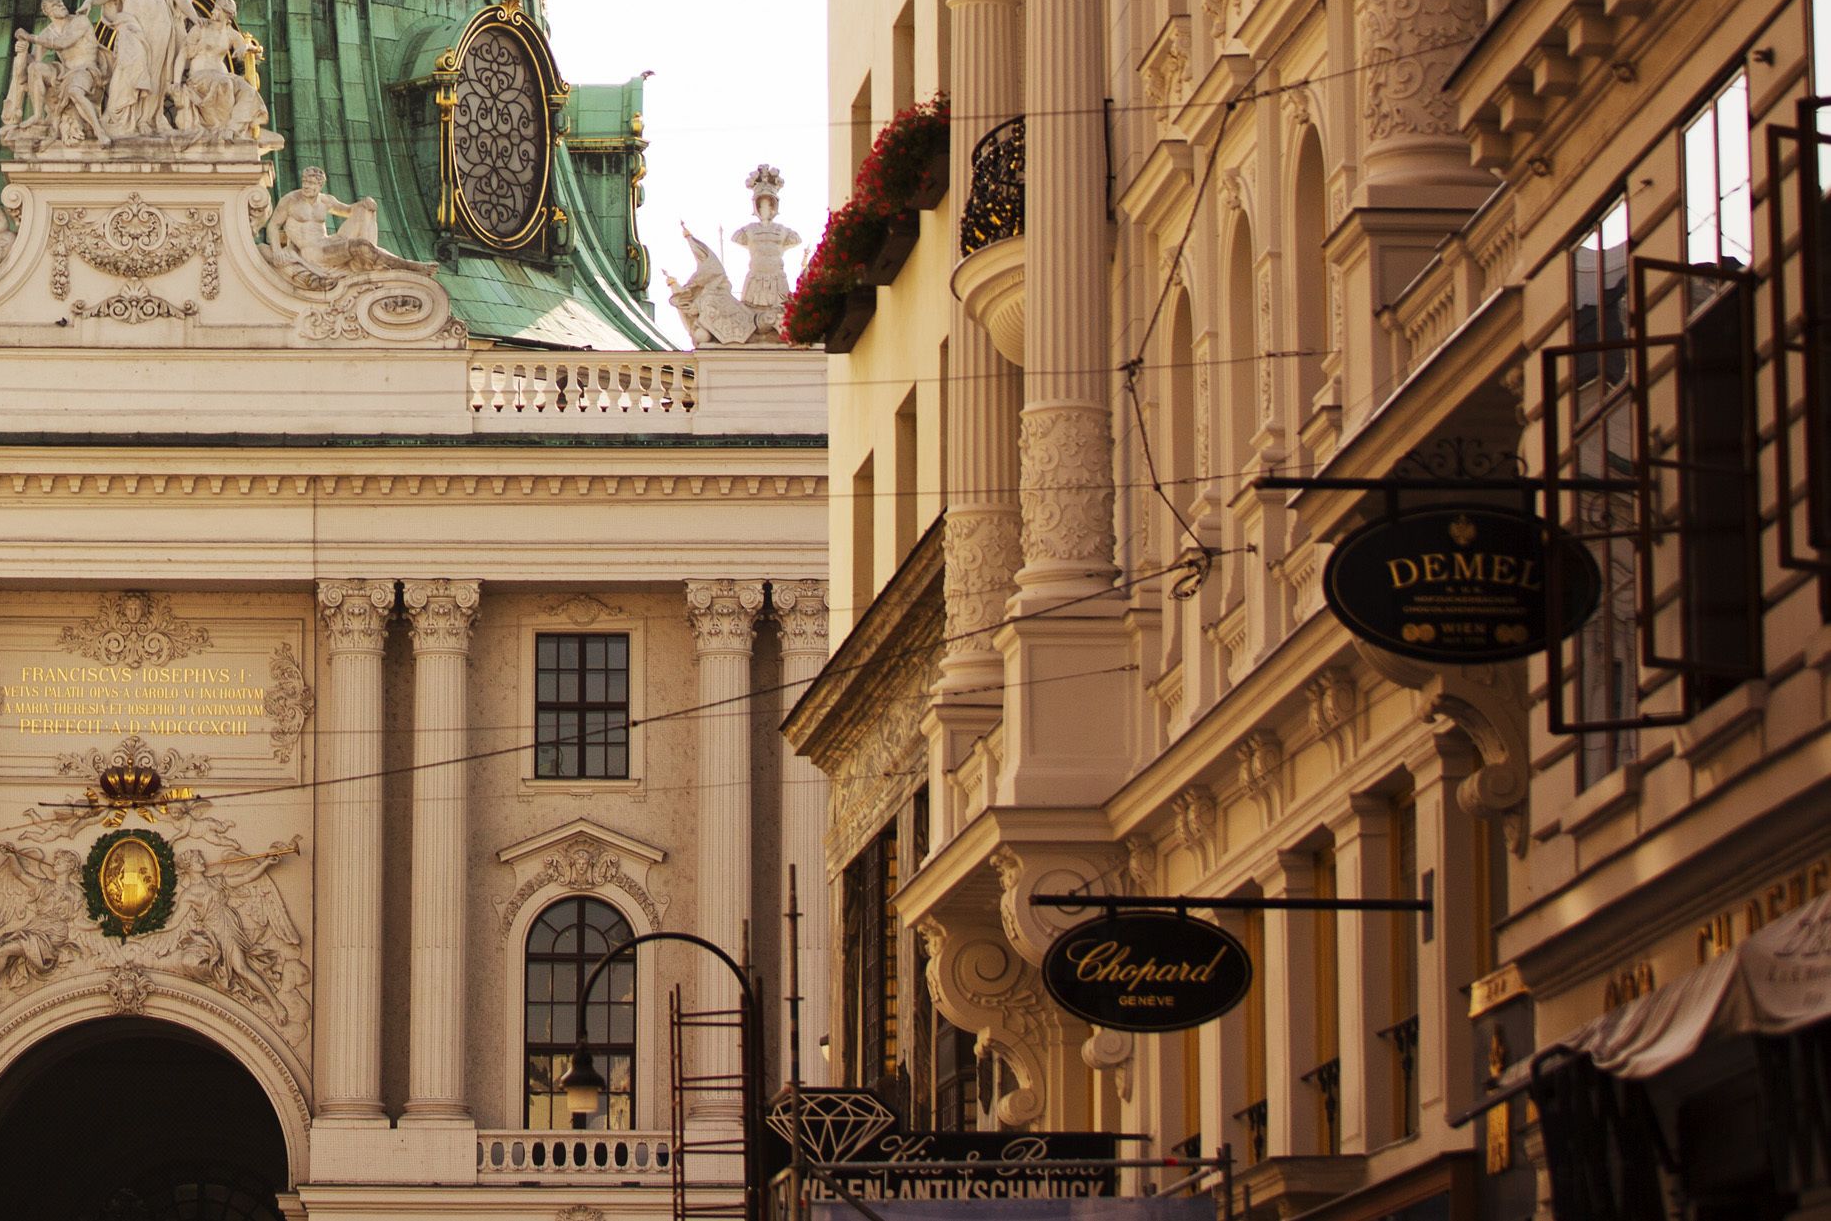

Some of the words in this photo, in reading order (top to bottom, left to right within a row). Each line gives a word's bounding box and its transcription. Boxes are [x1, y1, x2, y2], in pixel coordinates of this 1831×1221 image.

[1386, 552, 1543, 591] DEMEL
[22, 667, 132, 683] FRANCISCVS
[142, 668, 230, 684] IOSEPHVS
[4, 685, 39, 697] VETVS
[89, 686, 119, 698] OPVS
[123, 686, 131, 698] A
[135, 687, 179, 699] CAROLO
[184, 688, 195, 699] VI
[200, 688, 265, 700] INCHOATVM
[4, 703, 12, 714] A
[16, 703, 49, 714] MARIA
[54, 703, 106, 715] THERESIA
[110, 704, 122, 715] ET
[128, 704, 175, 716] IOSEPHO
[191, 705, 265, 716] CONTINVATVM
[20, 719, 103, 734] PERFECIT
[110, 720, 122, 734] A
[130, 720, 140, 734] D
[151, 720, 247, 735] MDCCCXCIII
[1066, 938, 1228, 992] Chopard
